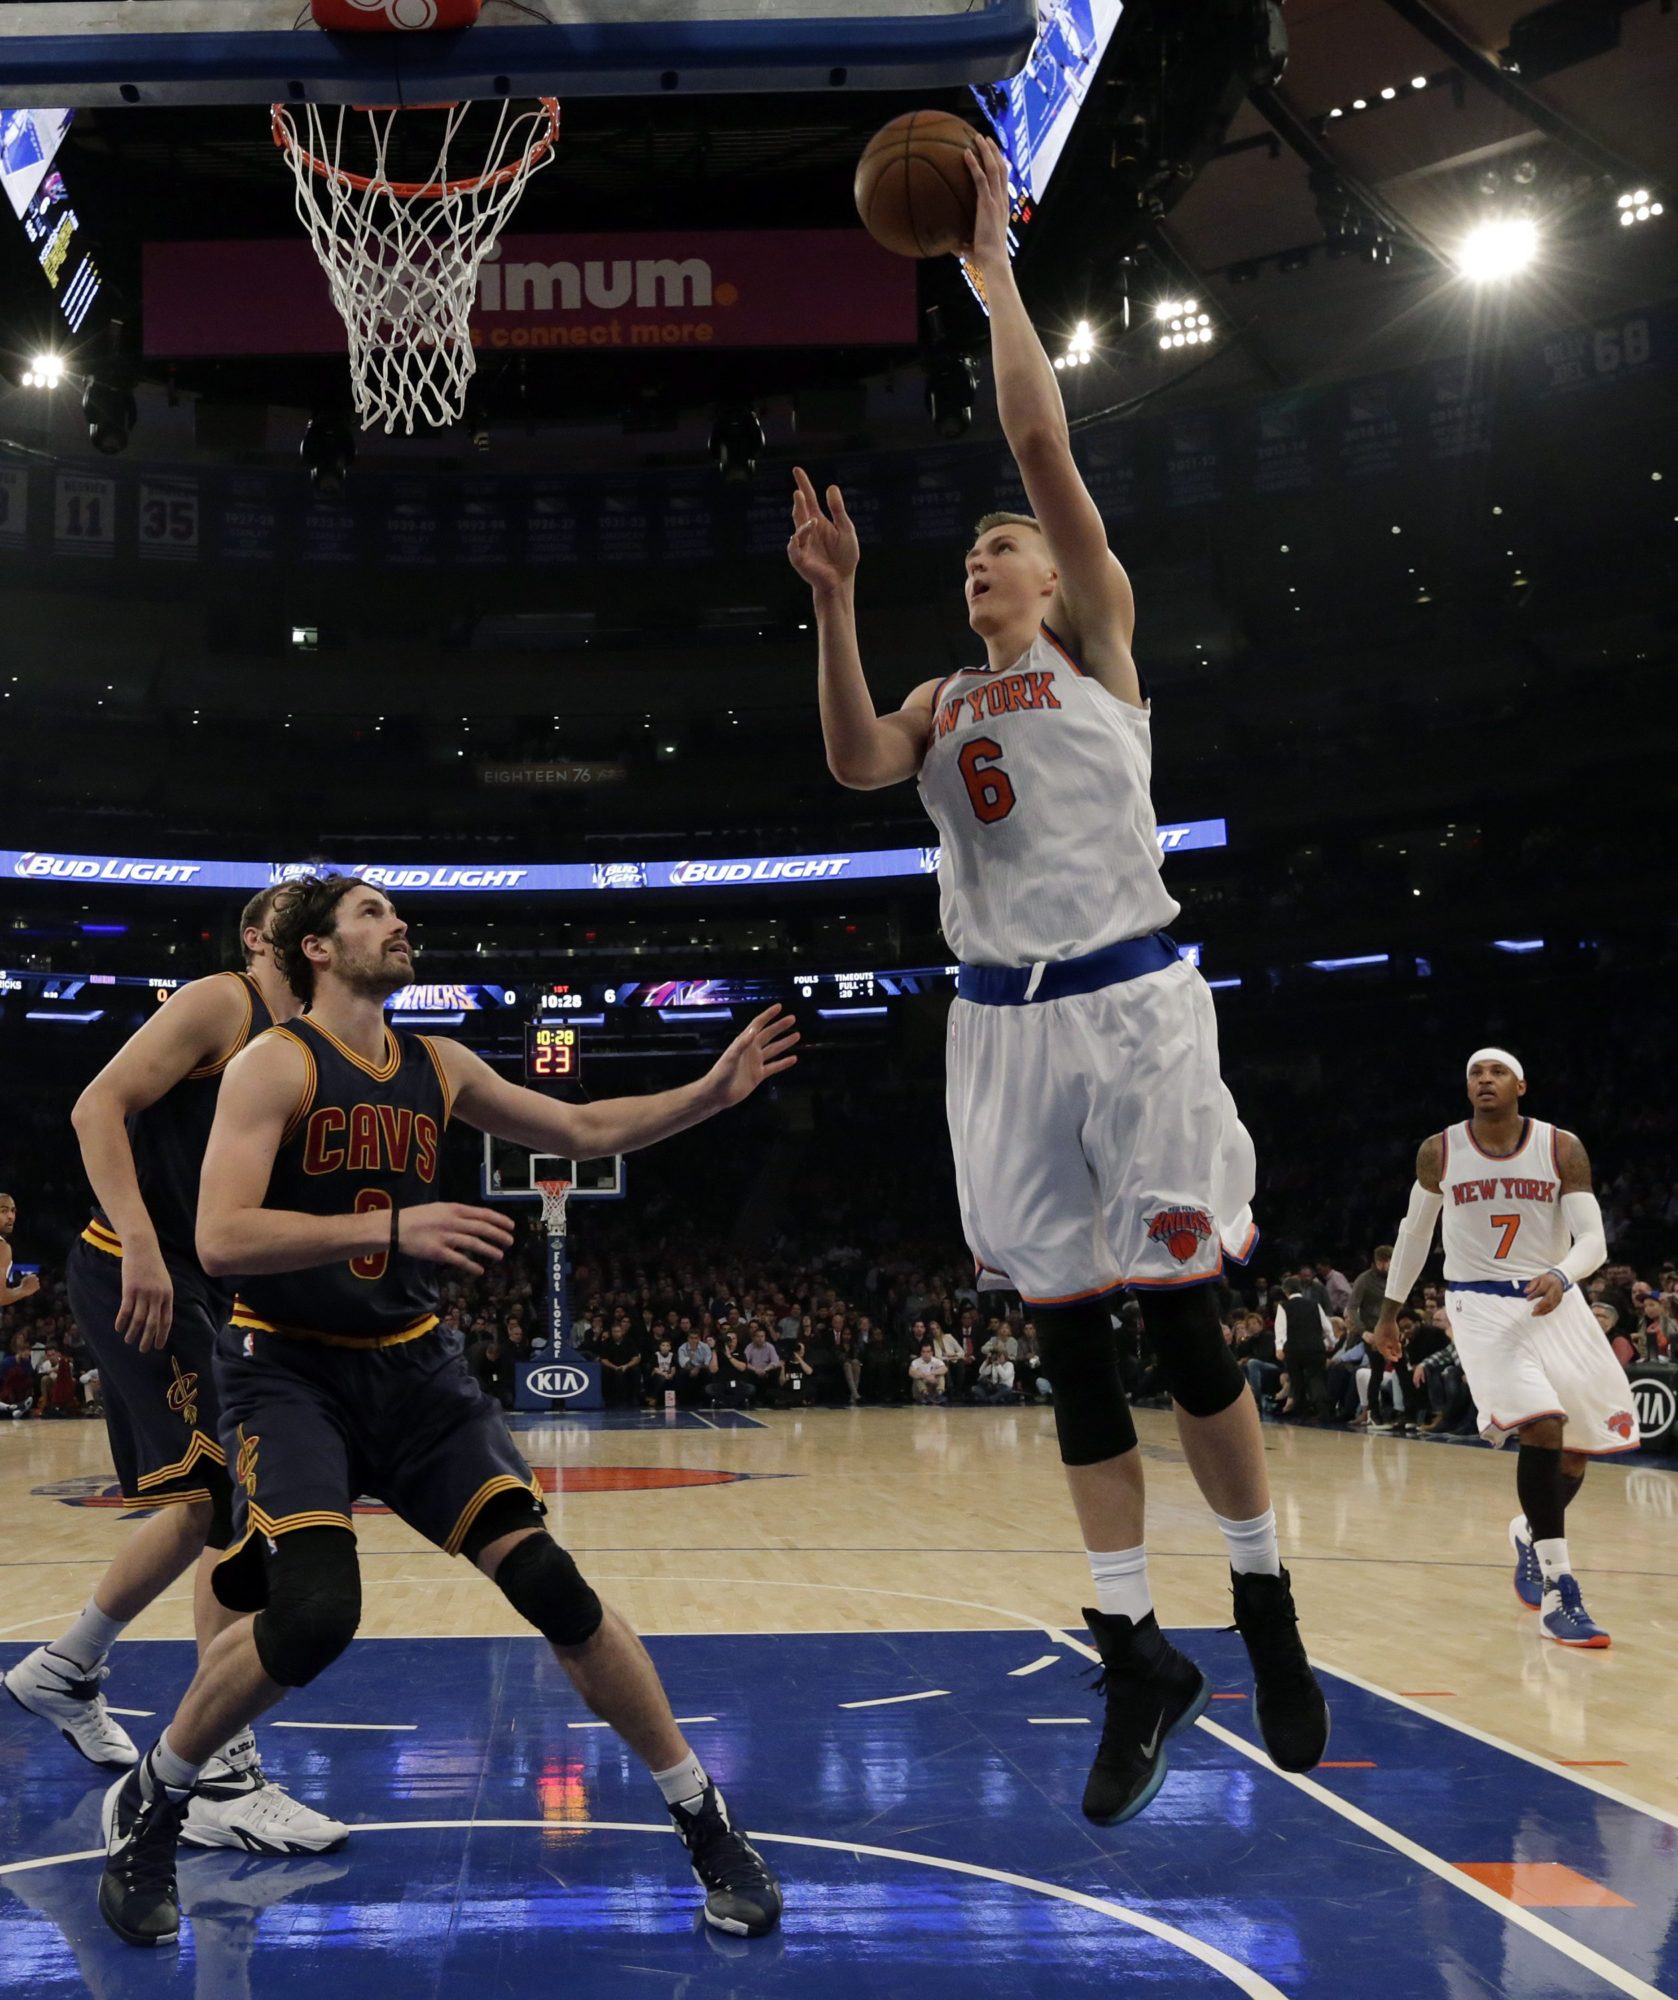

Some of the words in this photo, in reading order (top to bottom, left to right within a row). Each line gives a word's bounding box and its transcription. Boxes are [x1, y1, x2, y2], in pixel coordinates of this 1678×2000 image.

[491, 321, 622, 347] connect
[631, 322, 715, 346] more
[66, 495, 103, 537] 11
[143, 499, 195, 541] 35
[966, 671, 1061, 723] YORK
[484, 769, 568, 784] EIGHTEEN
[572, 767, 592, 783] 76
[957, 736, 1017, 825] 6
[25, 855, 101, 878] BUD
[100, 859, 200, 882] LIGHT
[361, 867, 433, 887] BUD
[430, 868, 528, 888] LIGHT
[680, 862, 752, 883] BUD
[750, 858, 851, 881] LIGHT
[148, 978, 177, 988] STEALS
[794, 975, 819, 985] FOULS
[834, 972, 874, 982] TIMEOUTS
[839, 981, 859, 991] FULL
[156, 988, 168, 1002] 0
[504, 990, 516, 1005] 0
[553, 985, 569, 994] 1ST
[604, 989, 616, 1004] 6
[802, 986, 813, 998] 0
[541, 994, 582, 1009] 10:28
[536, 1030, 575, 1046] 10:28
[536, 1046, 571, 1074] 23
[303, 1103, 438, 1184] CAVS
[1452, 1178, 1499, 1206] NEW
[1500, 1177, 1556, 1204] YORK
[1147, 1210, 1213, 1243] KNICKS
[1490, 1214, 1521, 1260] 7
[537, 1372, 579, 1391] KIA
